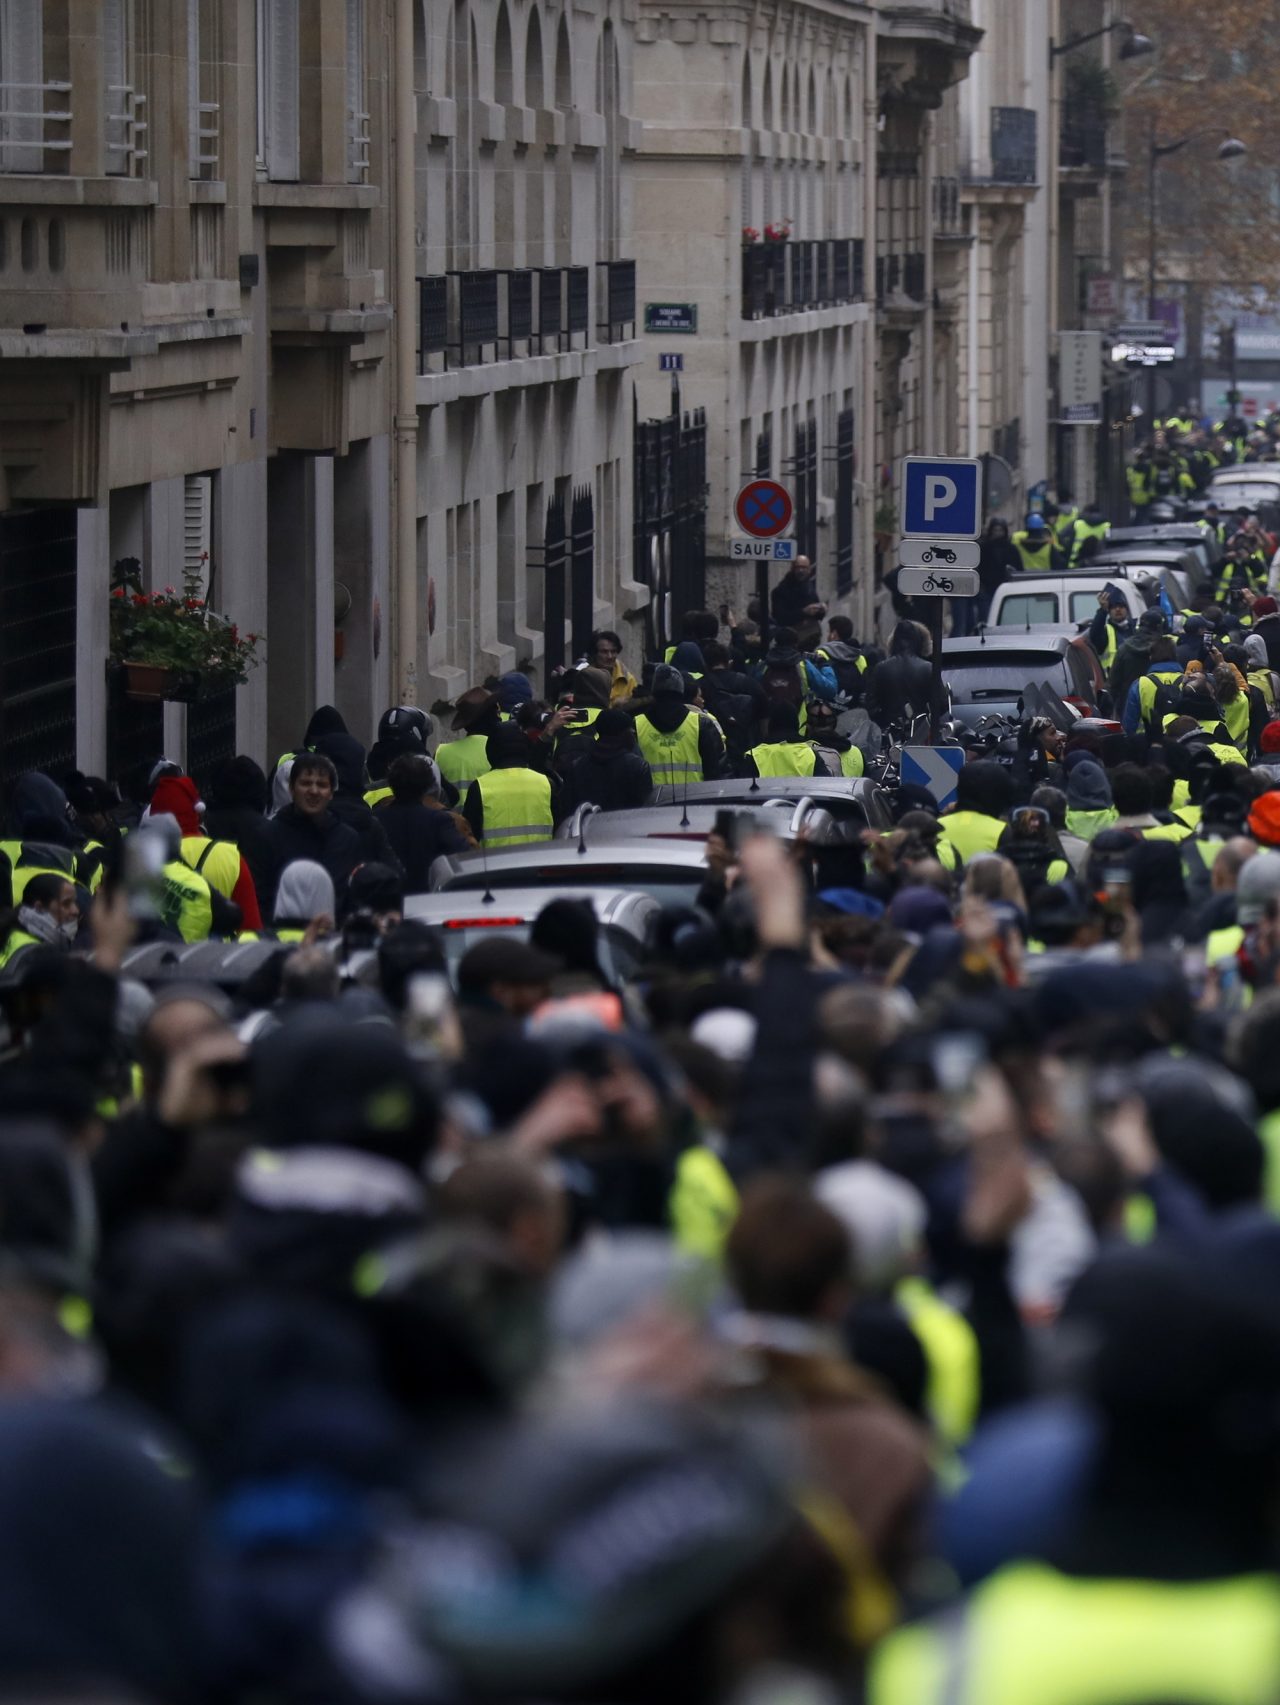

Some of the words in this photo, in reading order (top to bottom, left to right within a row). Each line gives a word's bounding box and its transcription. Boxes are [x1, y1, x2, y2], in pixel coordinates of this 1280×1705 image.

[665, 356, 678, 368] 11
[924, 475, 958, 521] P
[734, 543, 772, 556] SAUF
